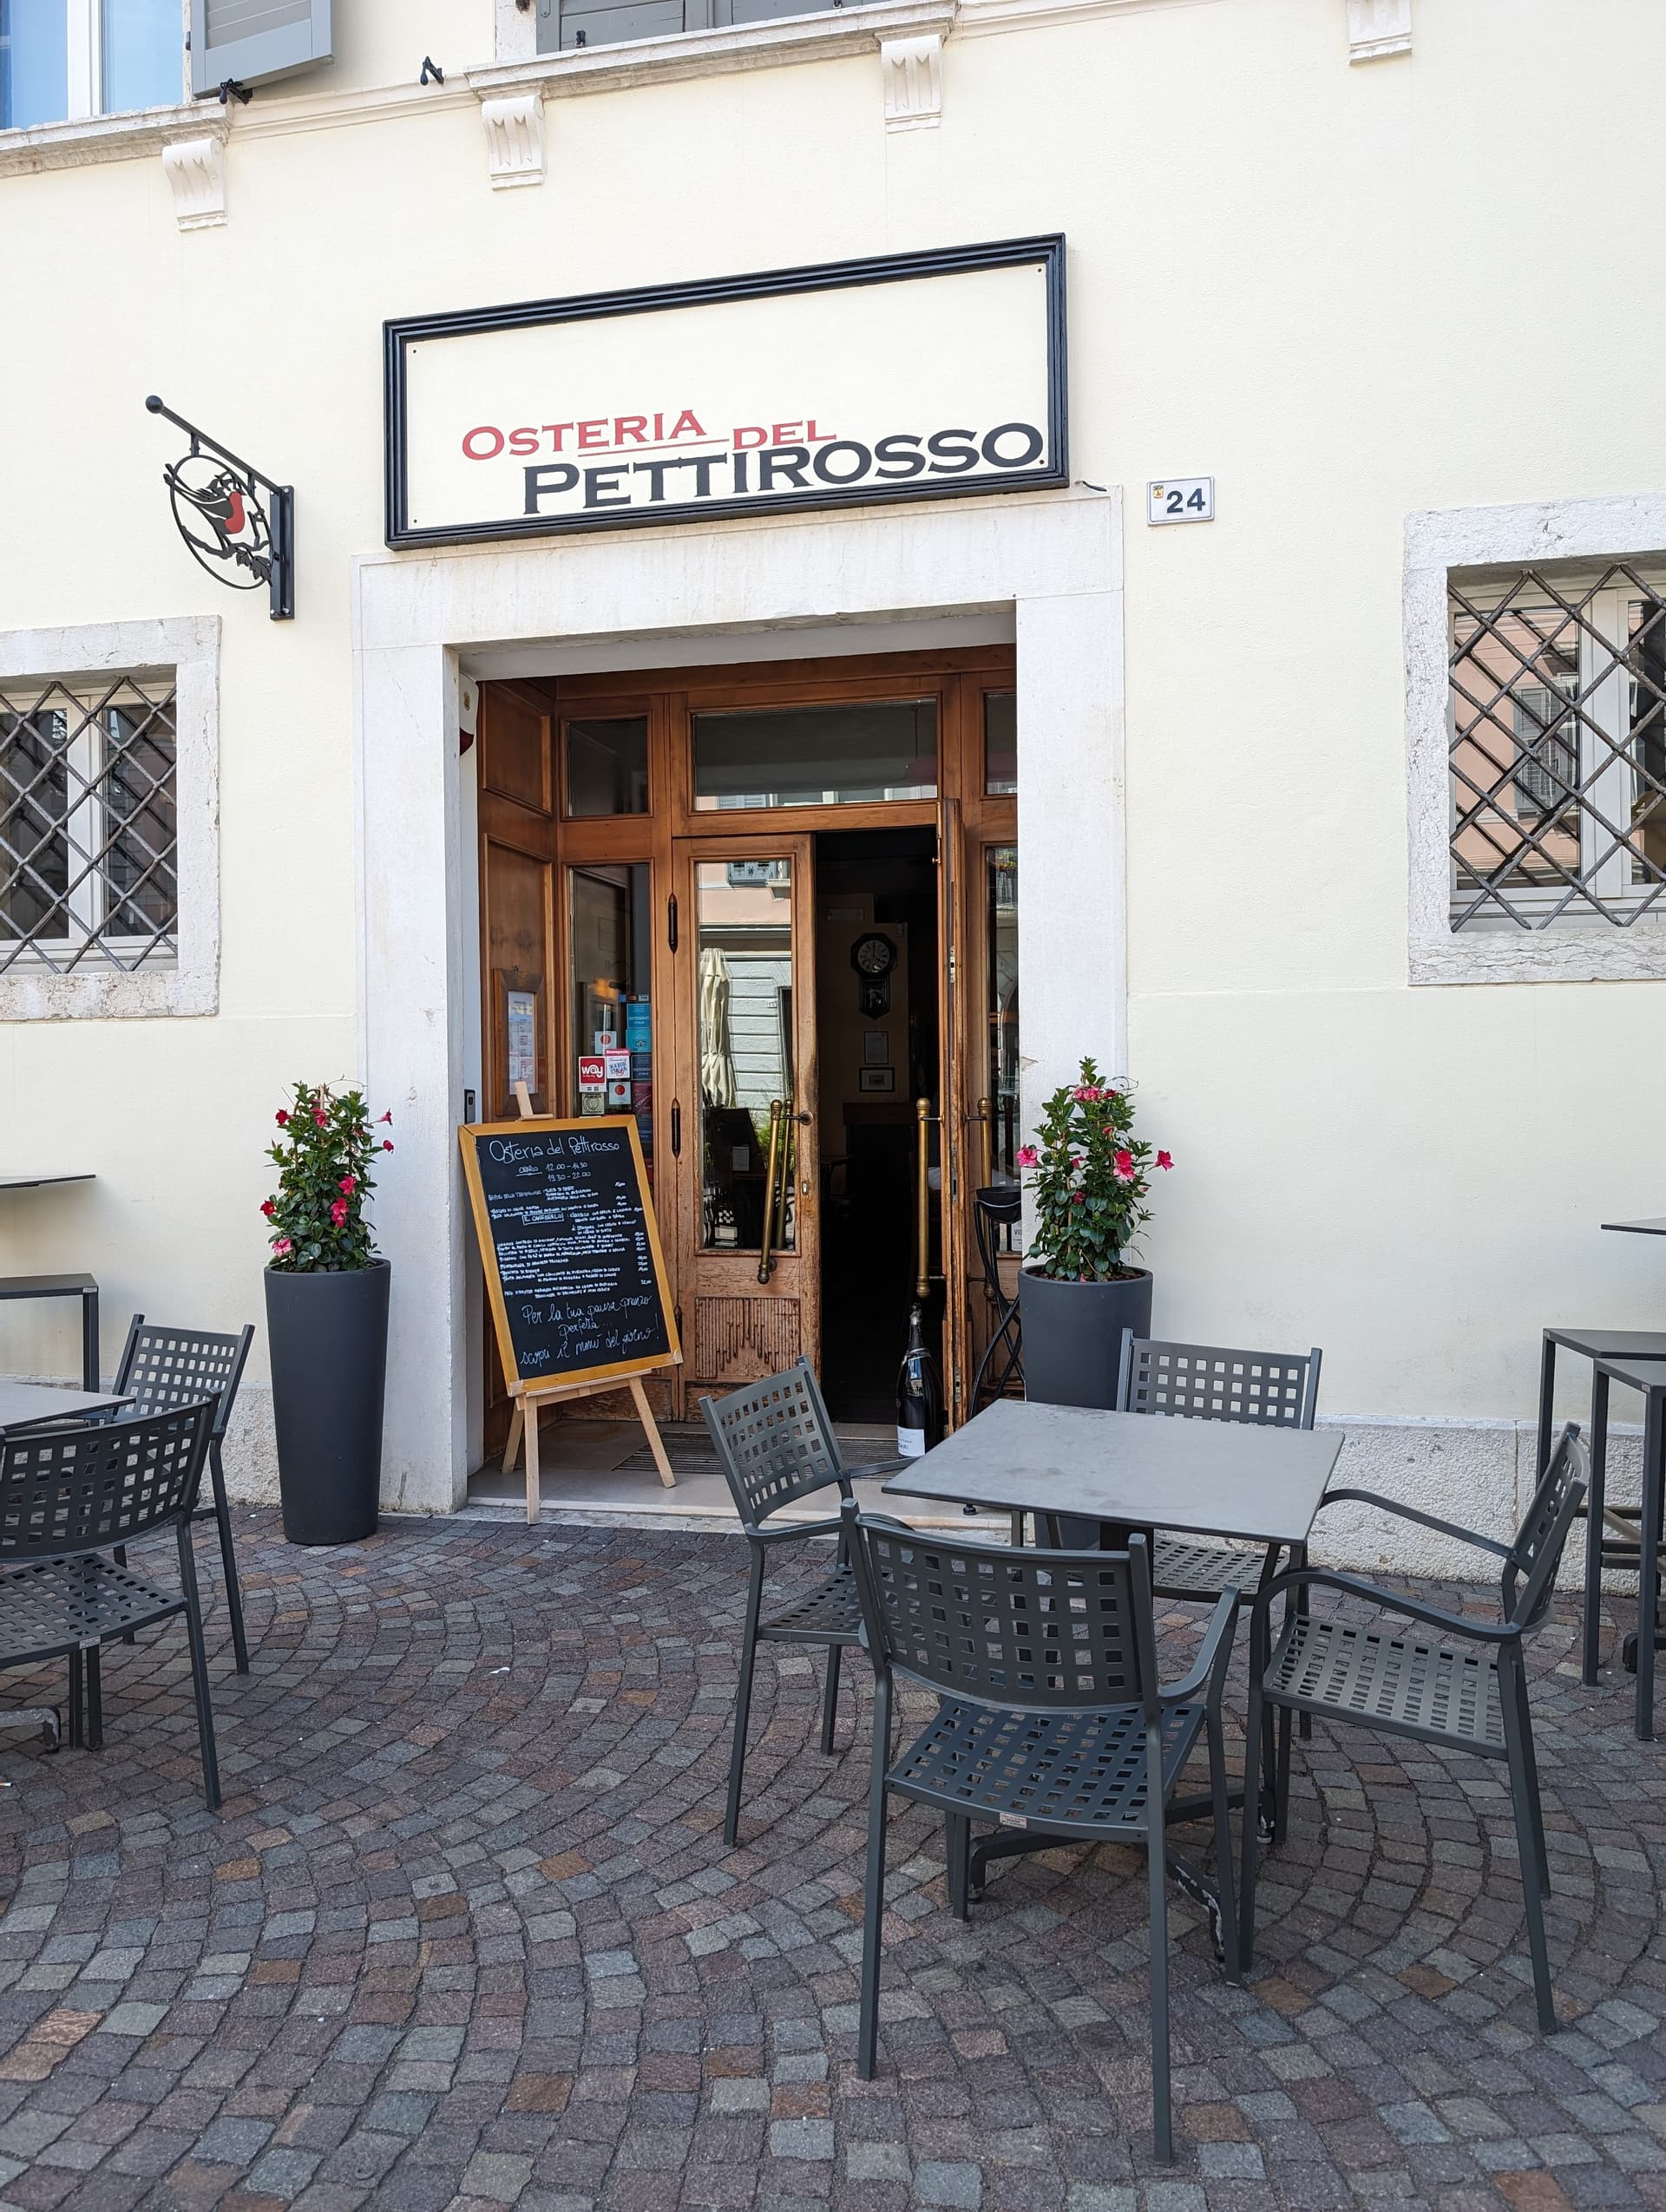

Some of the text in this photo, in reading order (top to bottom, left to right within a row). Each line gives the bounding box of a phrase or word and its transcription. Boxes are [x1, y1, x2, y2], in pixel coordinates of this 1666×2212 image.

[462, 410, 836, 461] OSTERIA DEL
[523, 422, 1045, 515] PETTIROSSO
[1166, 488, 1206, 514] 24
[489, 1135, 620, 1164] Osteria del Pettirosso
[521, 1295, 653, 1325] Per la tua pausa pranzo
[521, 1345, 550, 1367] scopri
[556, 1340, 570, 1359] il
[606, 1329, 620, 1349] del
